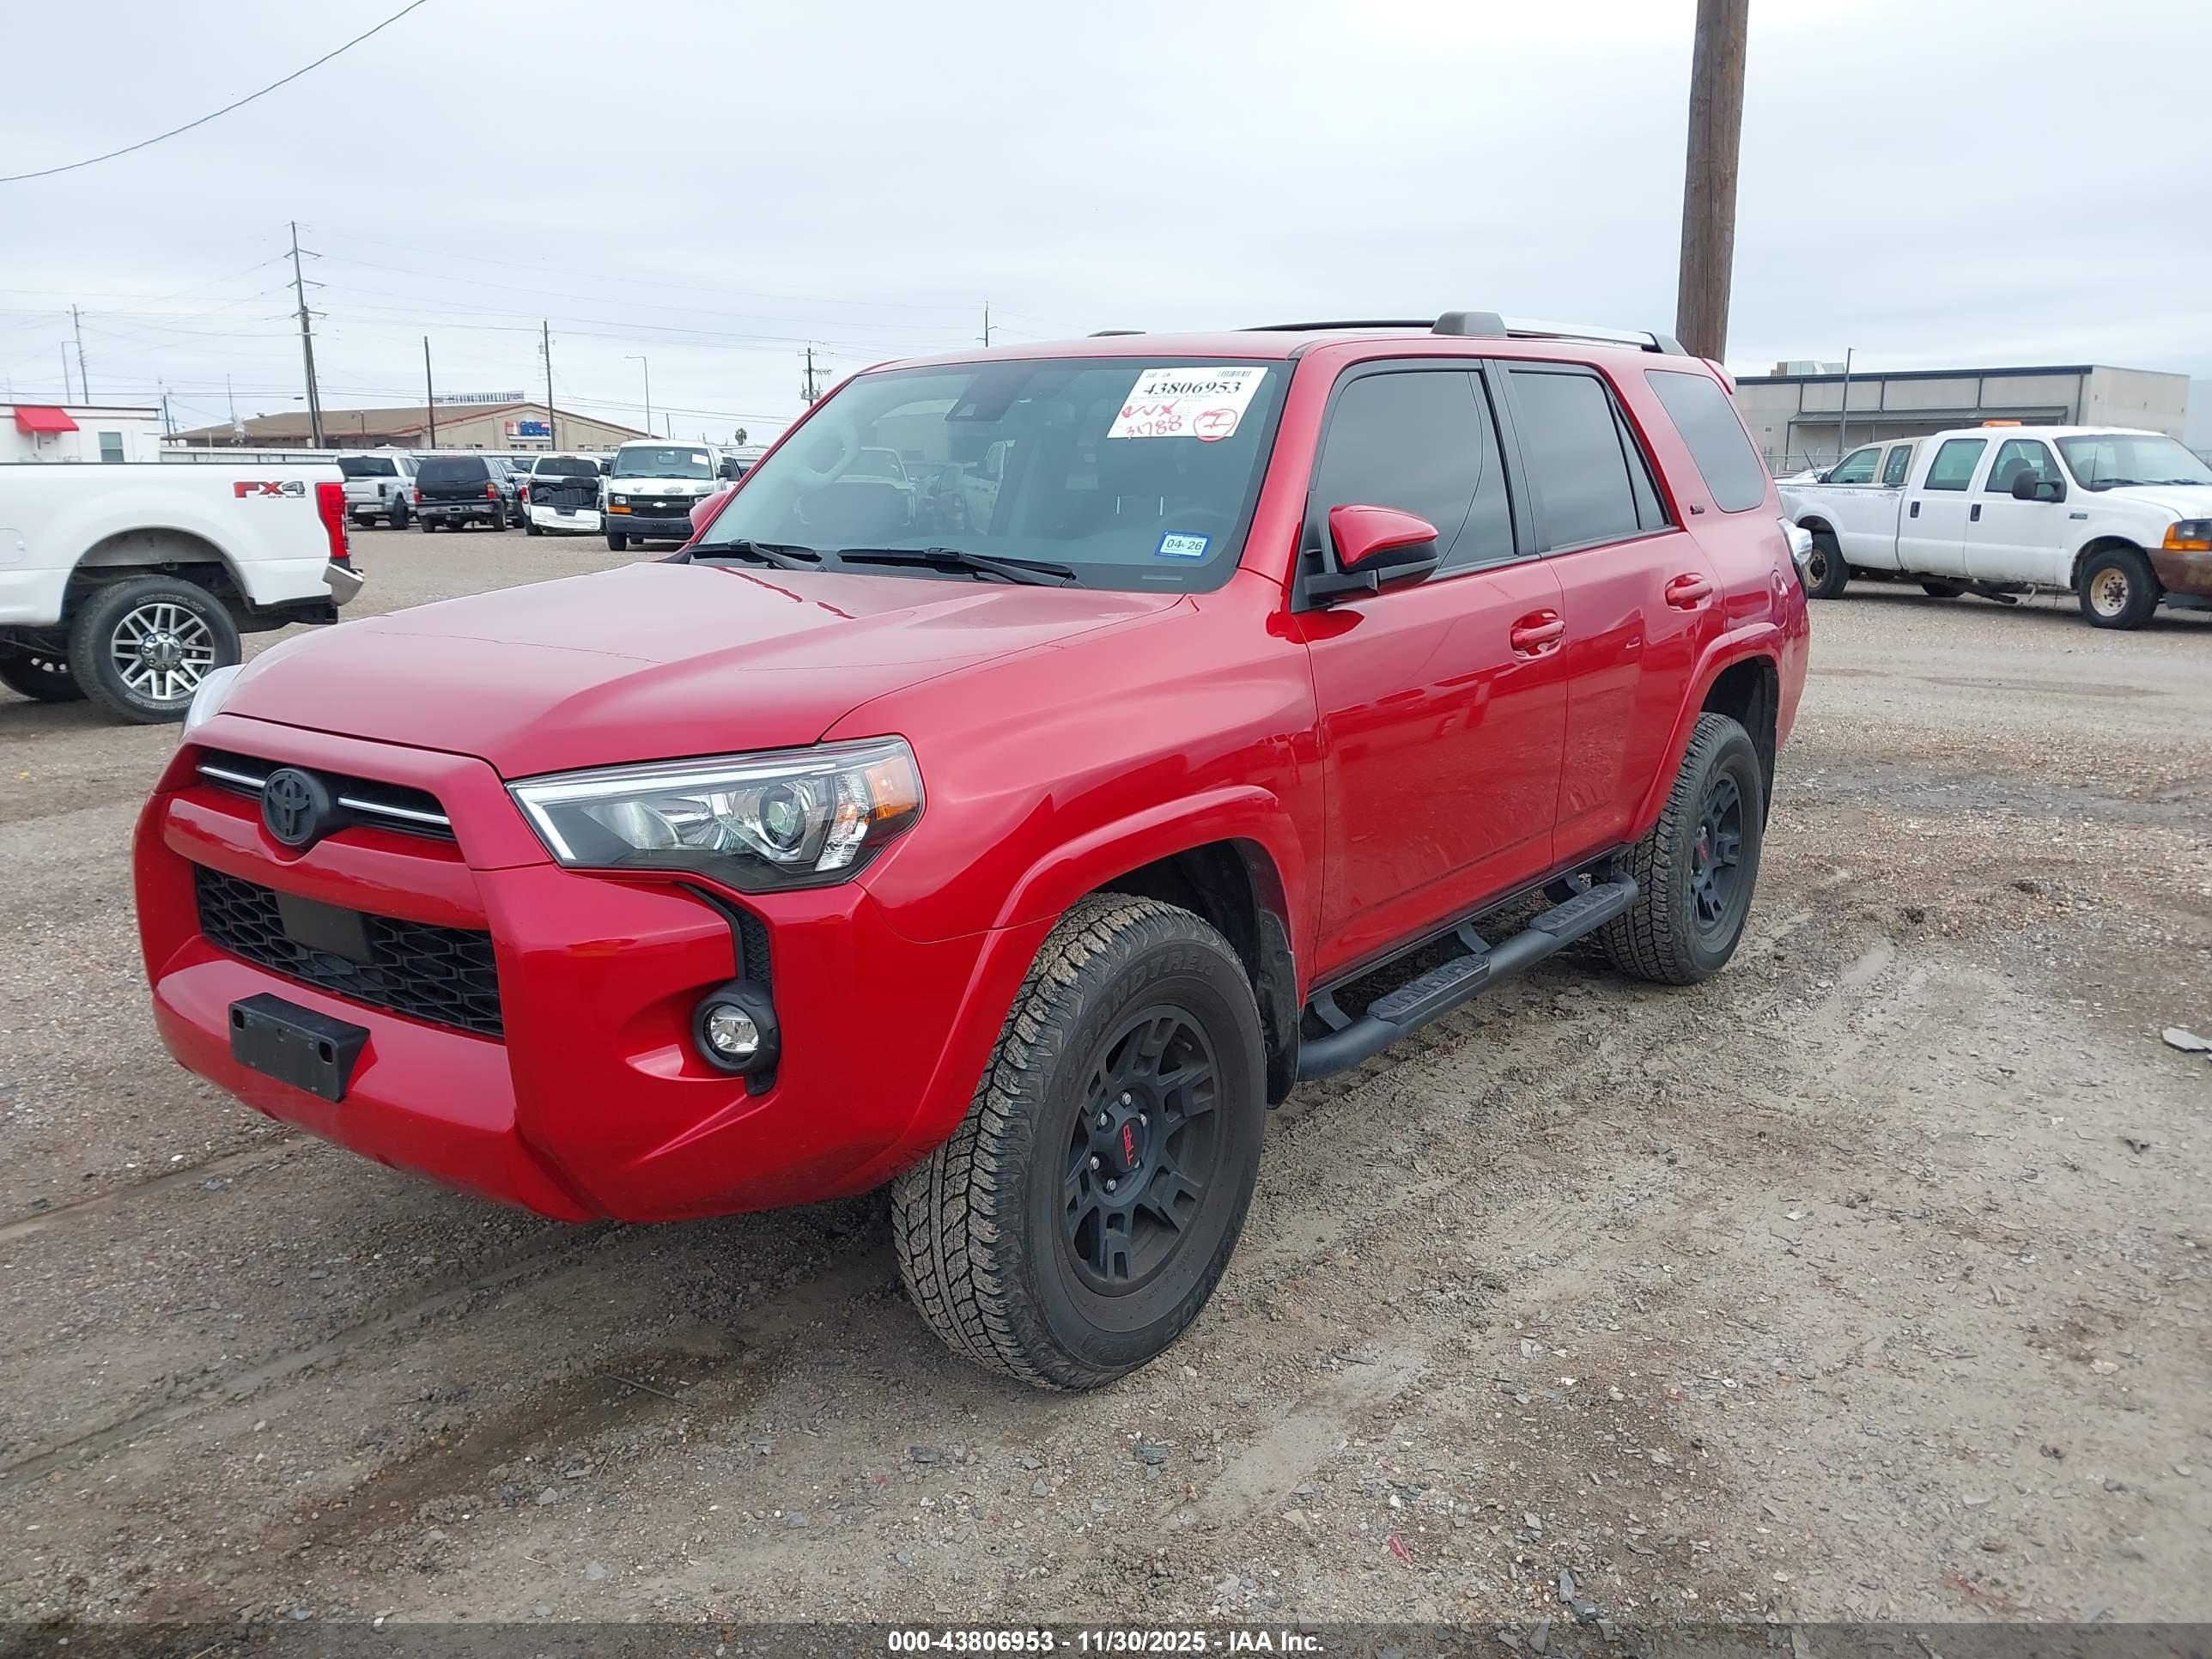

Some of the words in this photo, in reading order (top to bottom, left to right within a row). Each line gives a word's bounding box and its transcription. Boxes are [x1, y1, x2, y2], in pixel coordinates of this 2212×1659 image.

[1144, 381, 1242, 395] 43806953
[233, 481, 306, 498] FX4
[1186, 540, 1203, 550] 26
[1123, 1124, 1134, 1166] TRD
